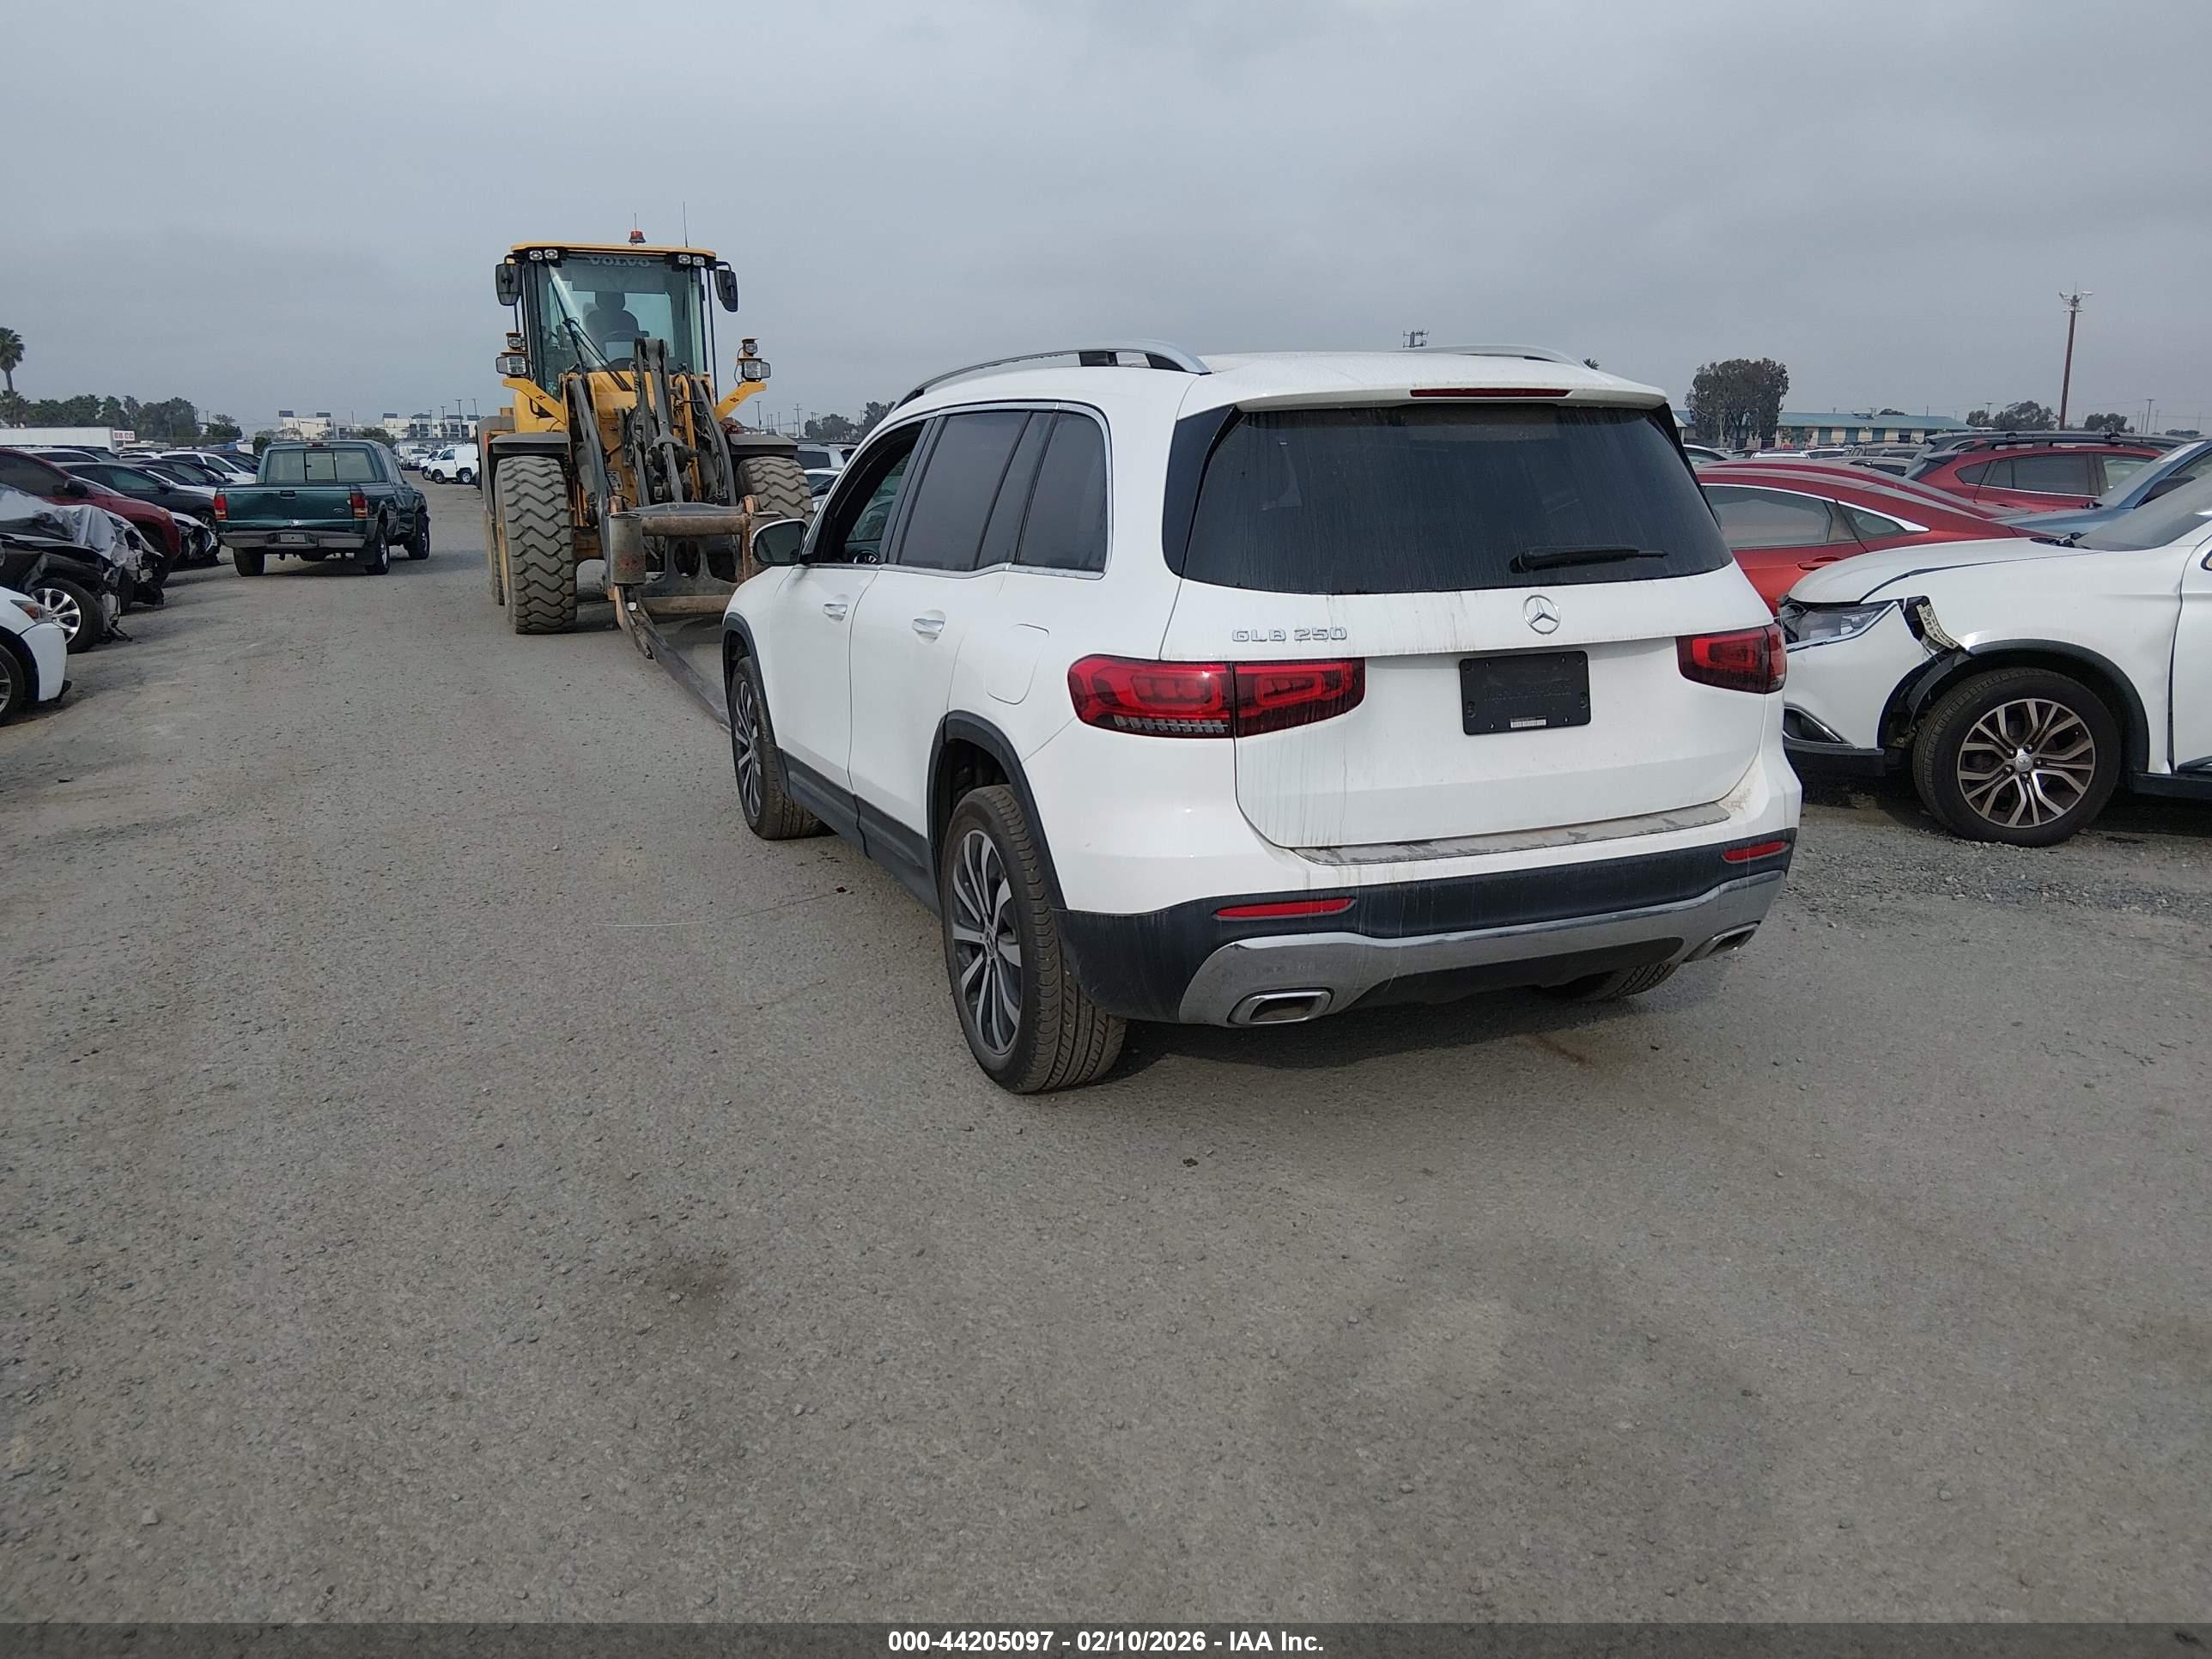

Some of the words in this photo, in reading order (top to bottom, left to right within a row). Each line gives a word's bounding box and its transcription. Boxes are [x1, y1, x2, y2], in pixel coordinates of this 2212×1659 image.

[589, 257, 651, 267] VOLVO
[1231, 629, 1287, 642] GLB
[1294, 627, 1348, 641] 250
